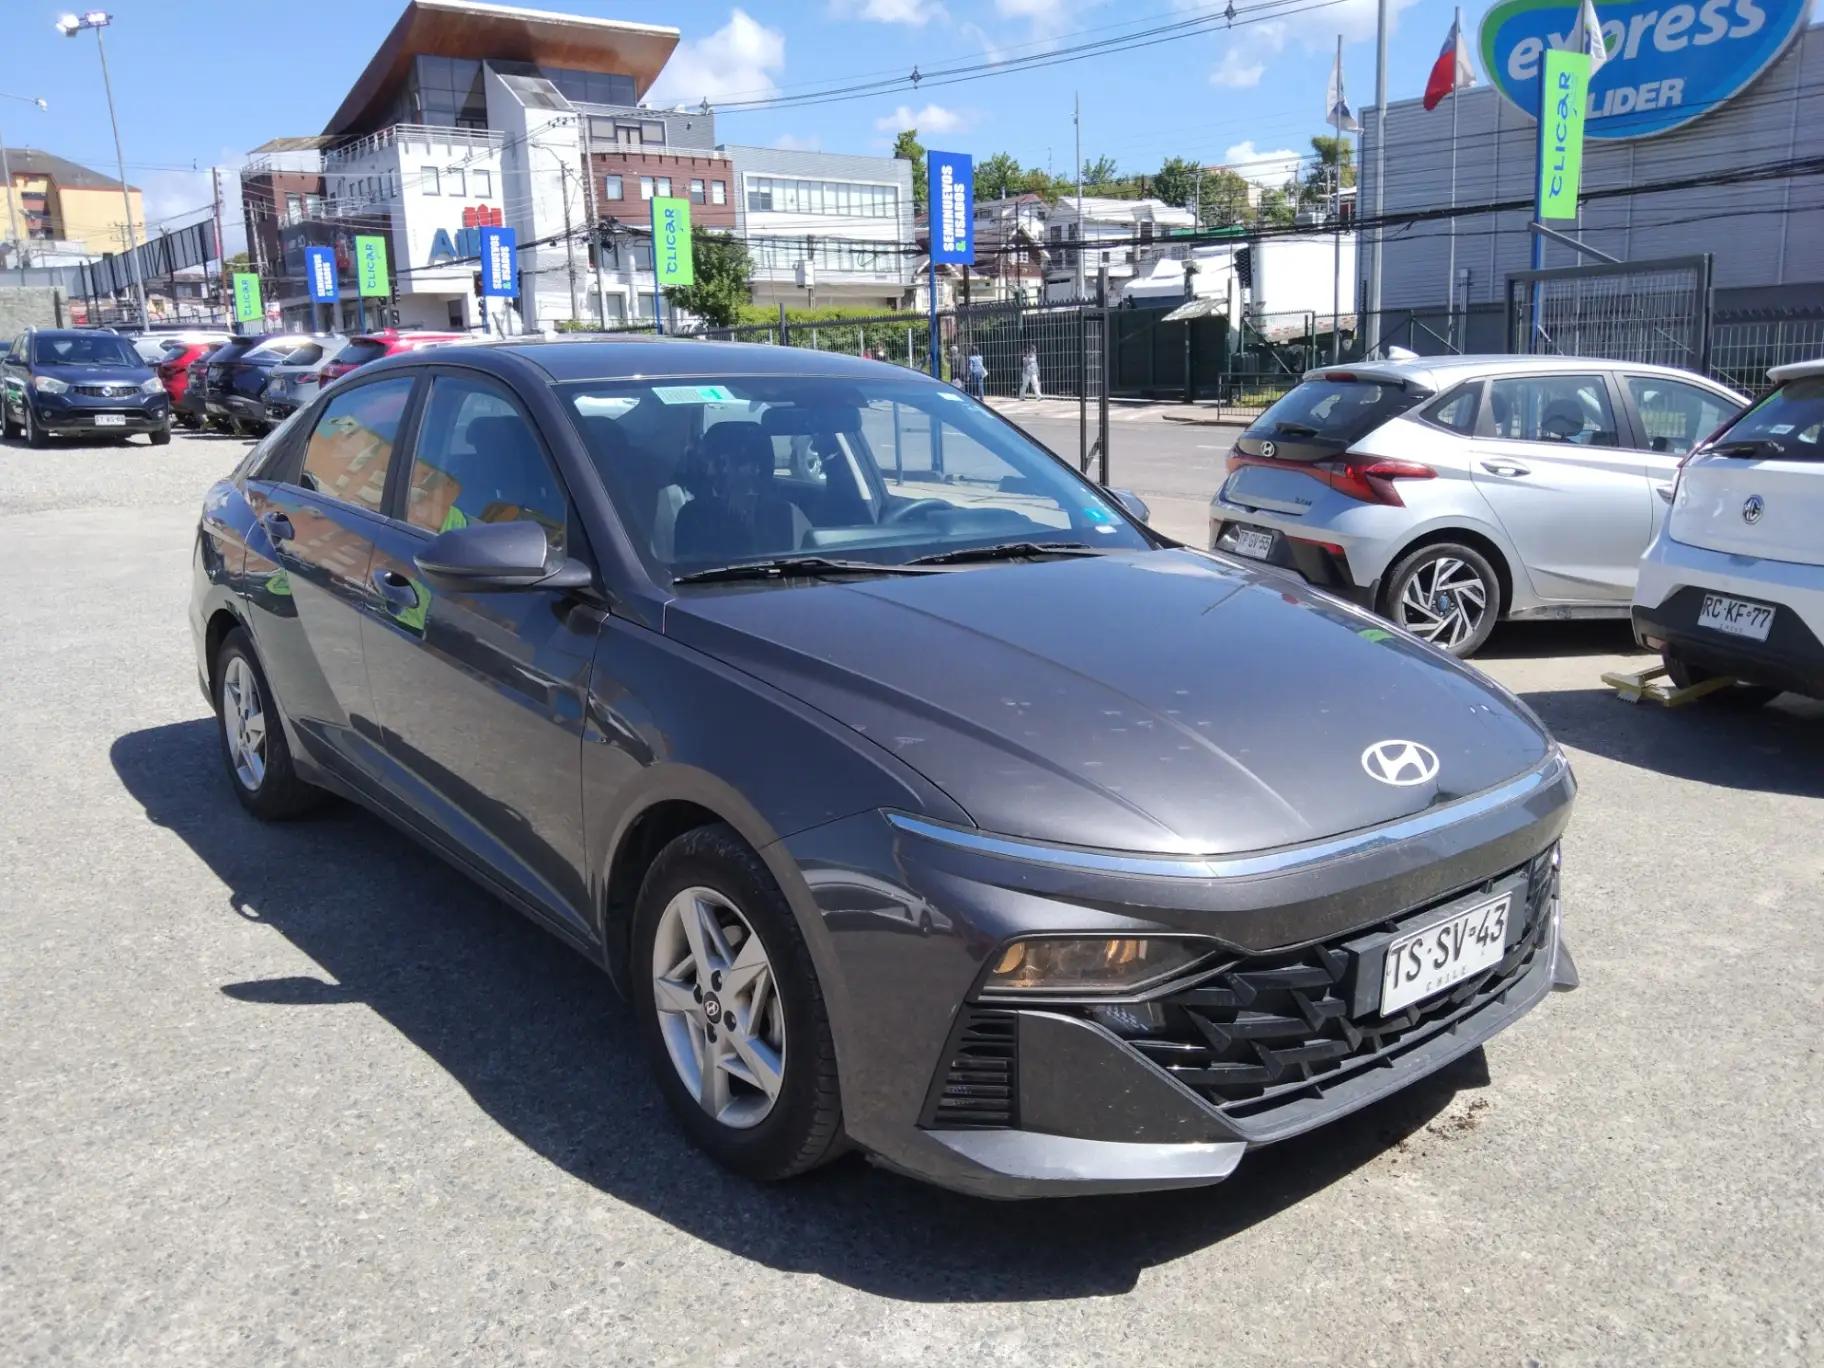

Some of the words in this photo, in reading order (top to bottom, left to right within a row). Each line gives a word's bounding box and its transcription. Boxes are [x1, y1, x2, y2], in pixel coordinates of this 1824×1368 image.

[1507, 0, 1766, 81] eress
[1586, 77, 1684, 120] LIDER
[941, 165, 955, 252] SEMINUEVOS
[953, 183, 967, 238] USADOS
[489, 234, 503, 290] SEMINUEVOS
[500, 246, 512, 281] USADOS
[955, 240, 967, 253] &
